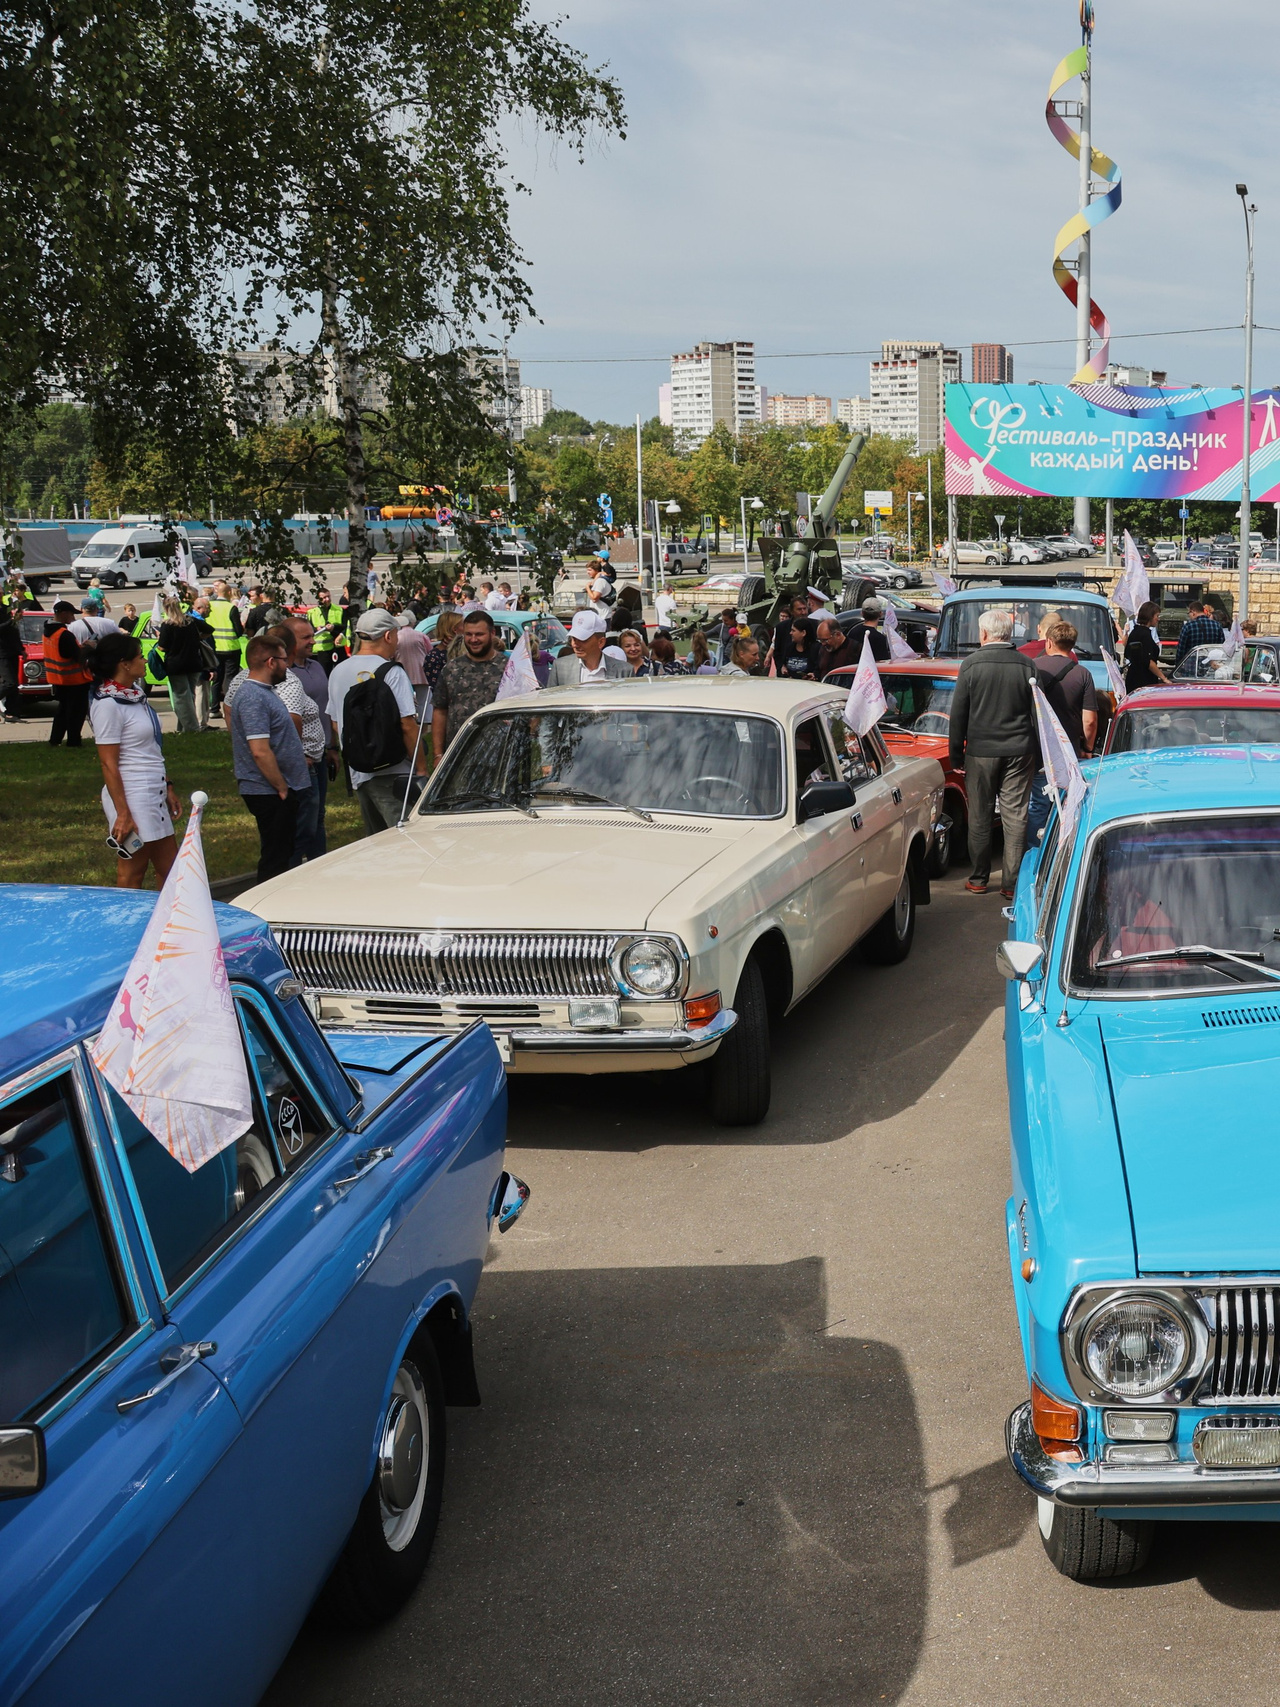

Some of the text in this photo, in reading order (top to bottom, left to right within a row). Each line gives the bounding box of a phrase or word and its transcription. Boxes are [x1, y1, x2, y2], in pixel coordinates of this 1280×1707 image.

[1030, 448, 1198, 472] каждый день!
[281, 1105, 294, 1122] СССР
